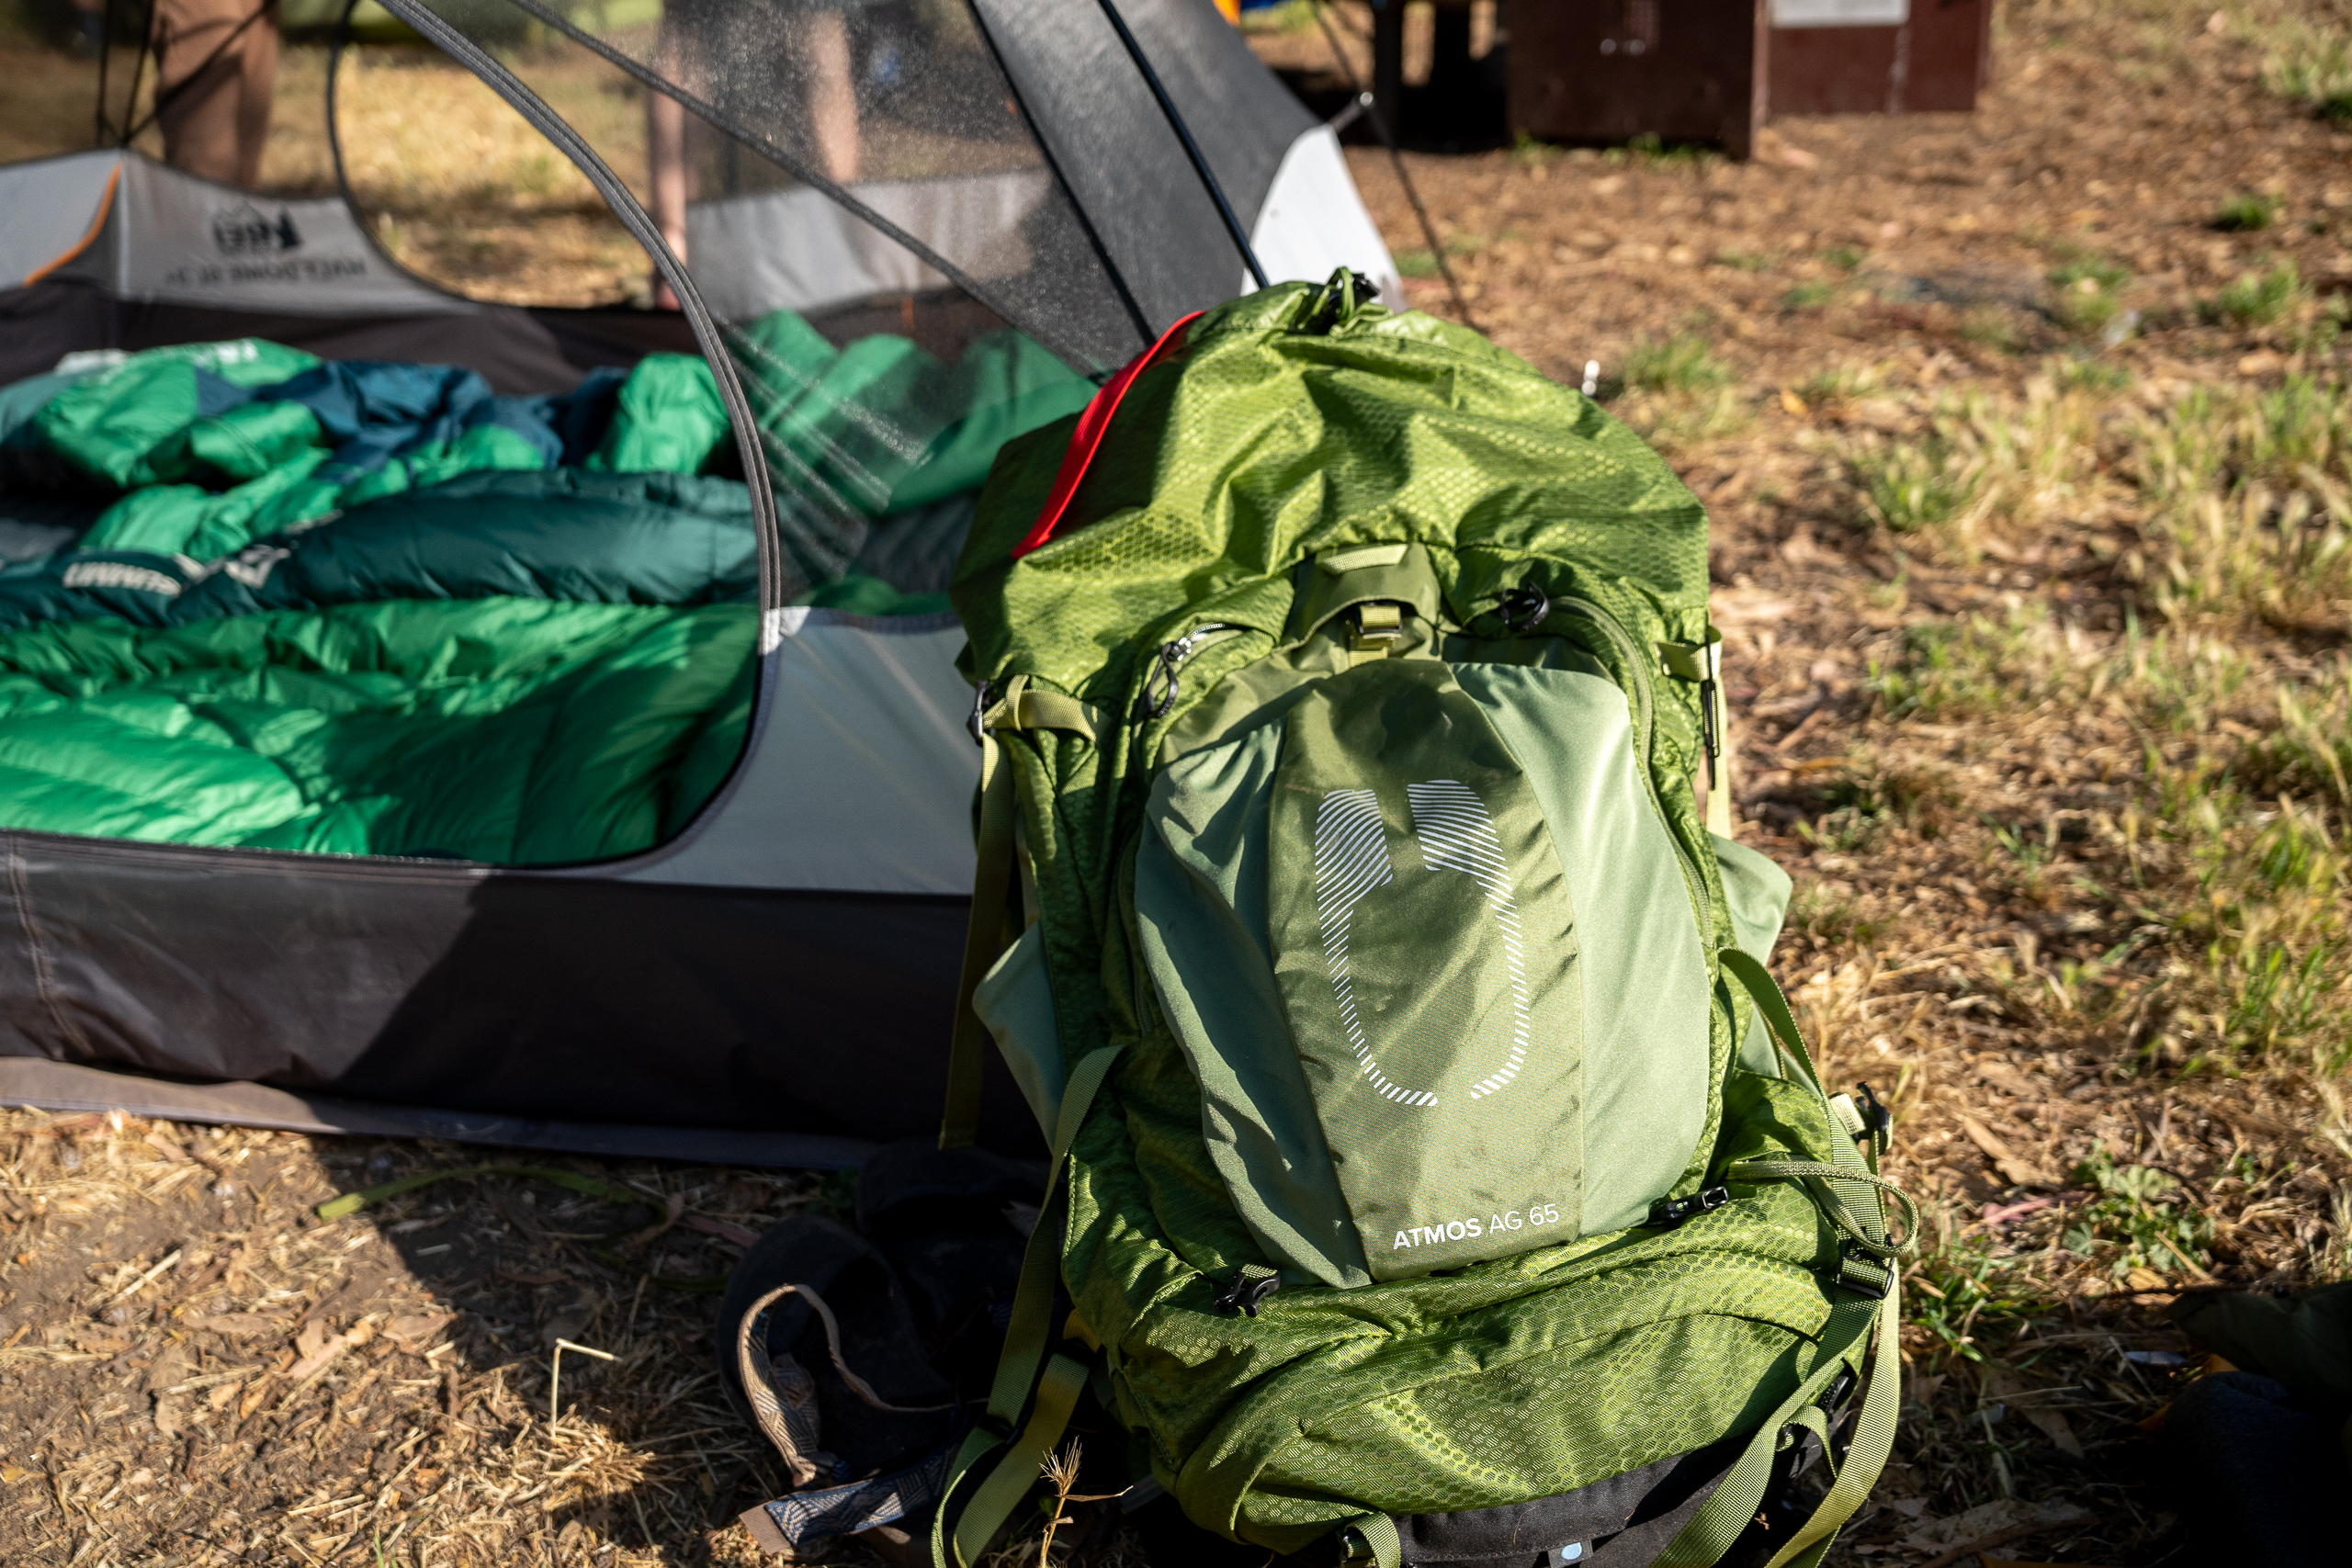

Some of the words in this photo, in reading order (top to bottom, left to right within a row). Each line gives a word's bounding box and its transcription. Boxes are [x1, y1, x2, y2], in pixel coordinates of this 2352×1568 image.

[1393, 1217, 1482, 1250] ATMOS
[1489, 1210, 1522, 1234] AG
[1529, 1202, 1560, 1226] 65
